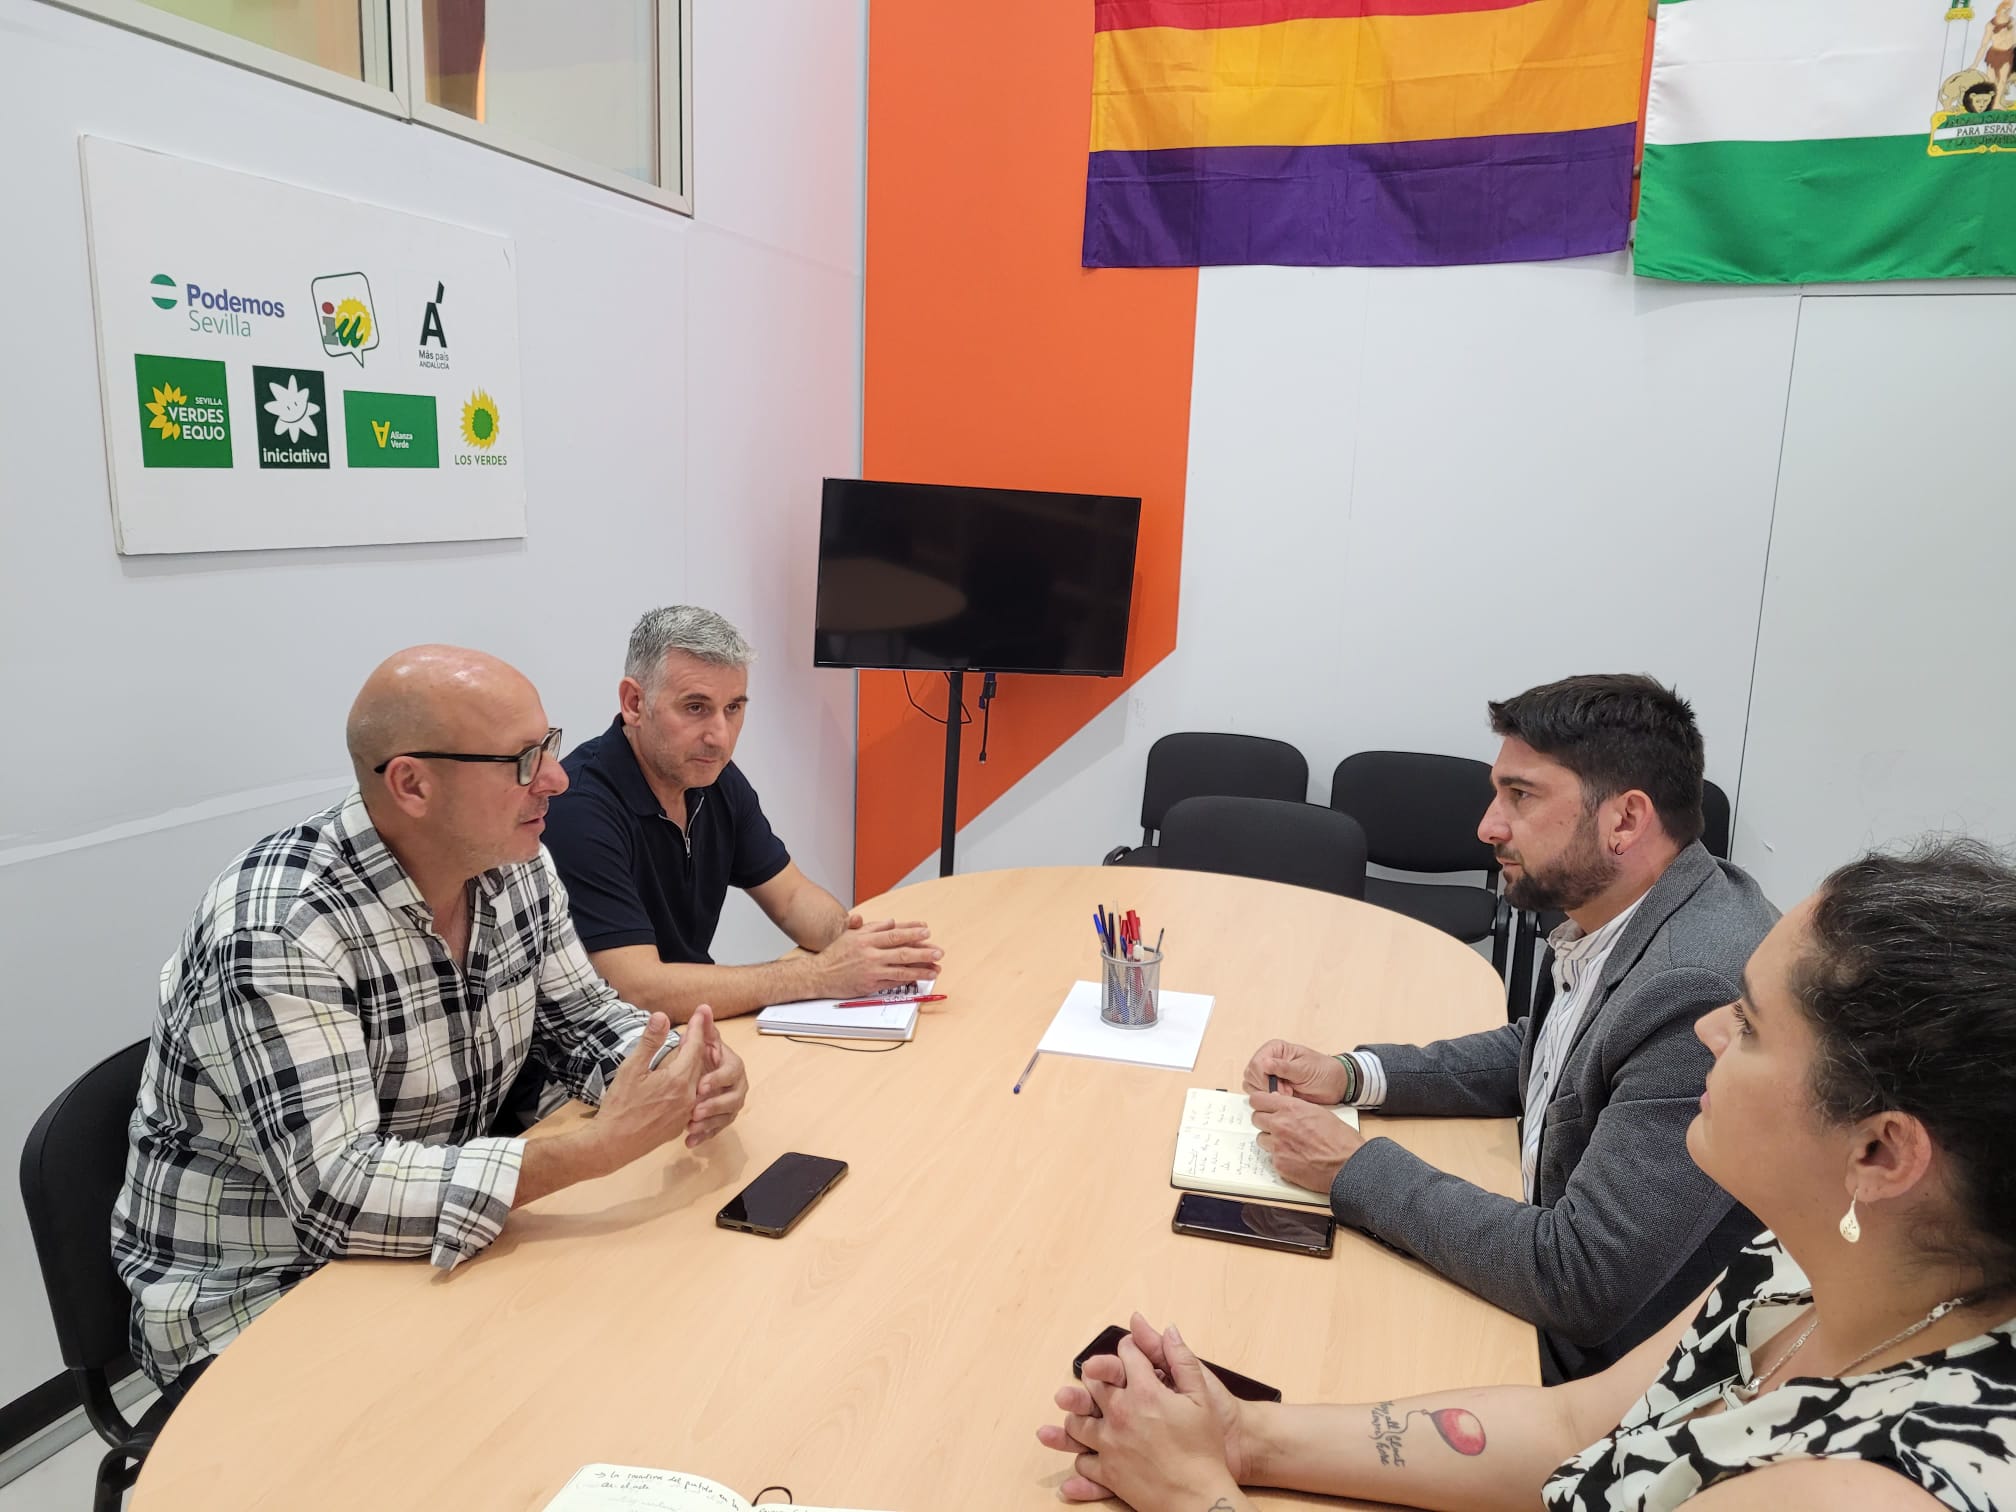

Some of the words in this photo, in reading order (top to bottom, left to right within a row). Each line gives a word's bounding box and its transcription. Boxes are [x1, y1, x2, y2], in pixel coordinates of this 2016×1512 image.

[1957, 127, 1980, 136] PARA
[186, 283, 285, 318] Podemos
[189, 310, 251, 337] Sevilla
[419, 350, 434, 360] Más
[195, 397, 223, 406] SEVILLA
[167, 406, 225, 424] VERDES
[182, 425, 225, 440] EQUO
[390, 439, 409, 449] Verde
[262, 447, 328, 463] iniciativa
[455, 455, 472, 465] LOS
[474, 455, 508, 466] VERDES
